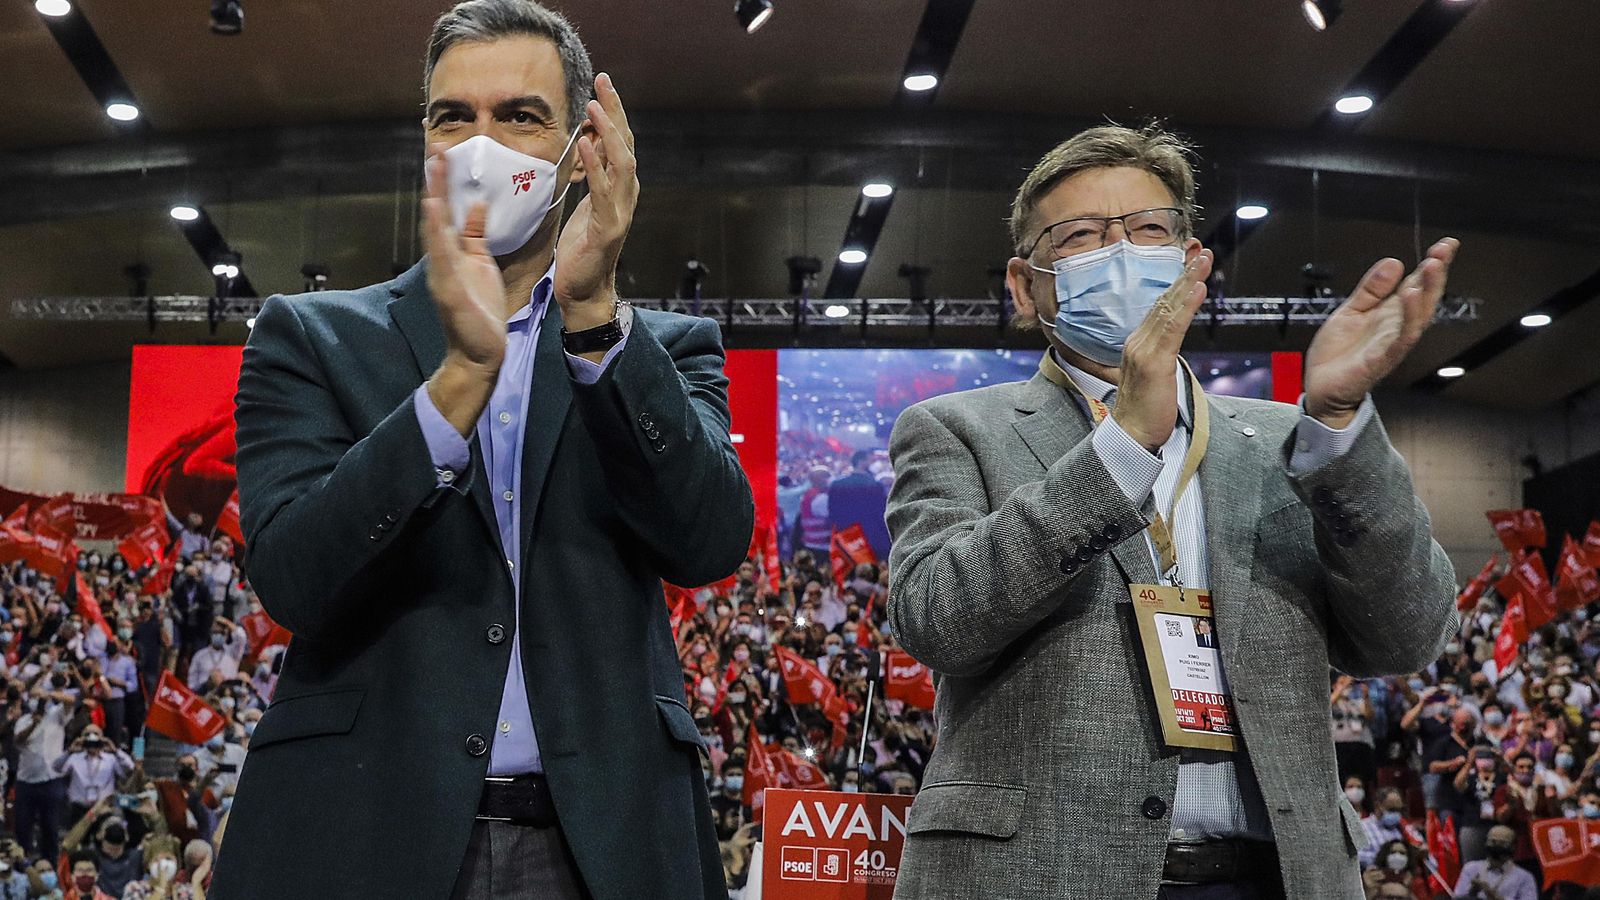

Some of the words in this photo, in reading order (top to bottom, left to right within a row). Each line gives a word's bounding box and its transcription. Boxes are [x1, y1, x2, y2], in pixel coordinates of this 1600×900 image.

[512, 170, 536, 185] PSOE
[1172, 689, 1225, 706] DELEGADO
[784, 861, 812, 873] PSOE
[853, 869, 896, 877] CONGRESO
